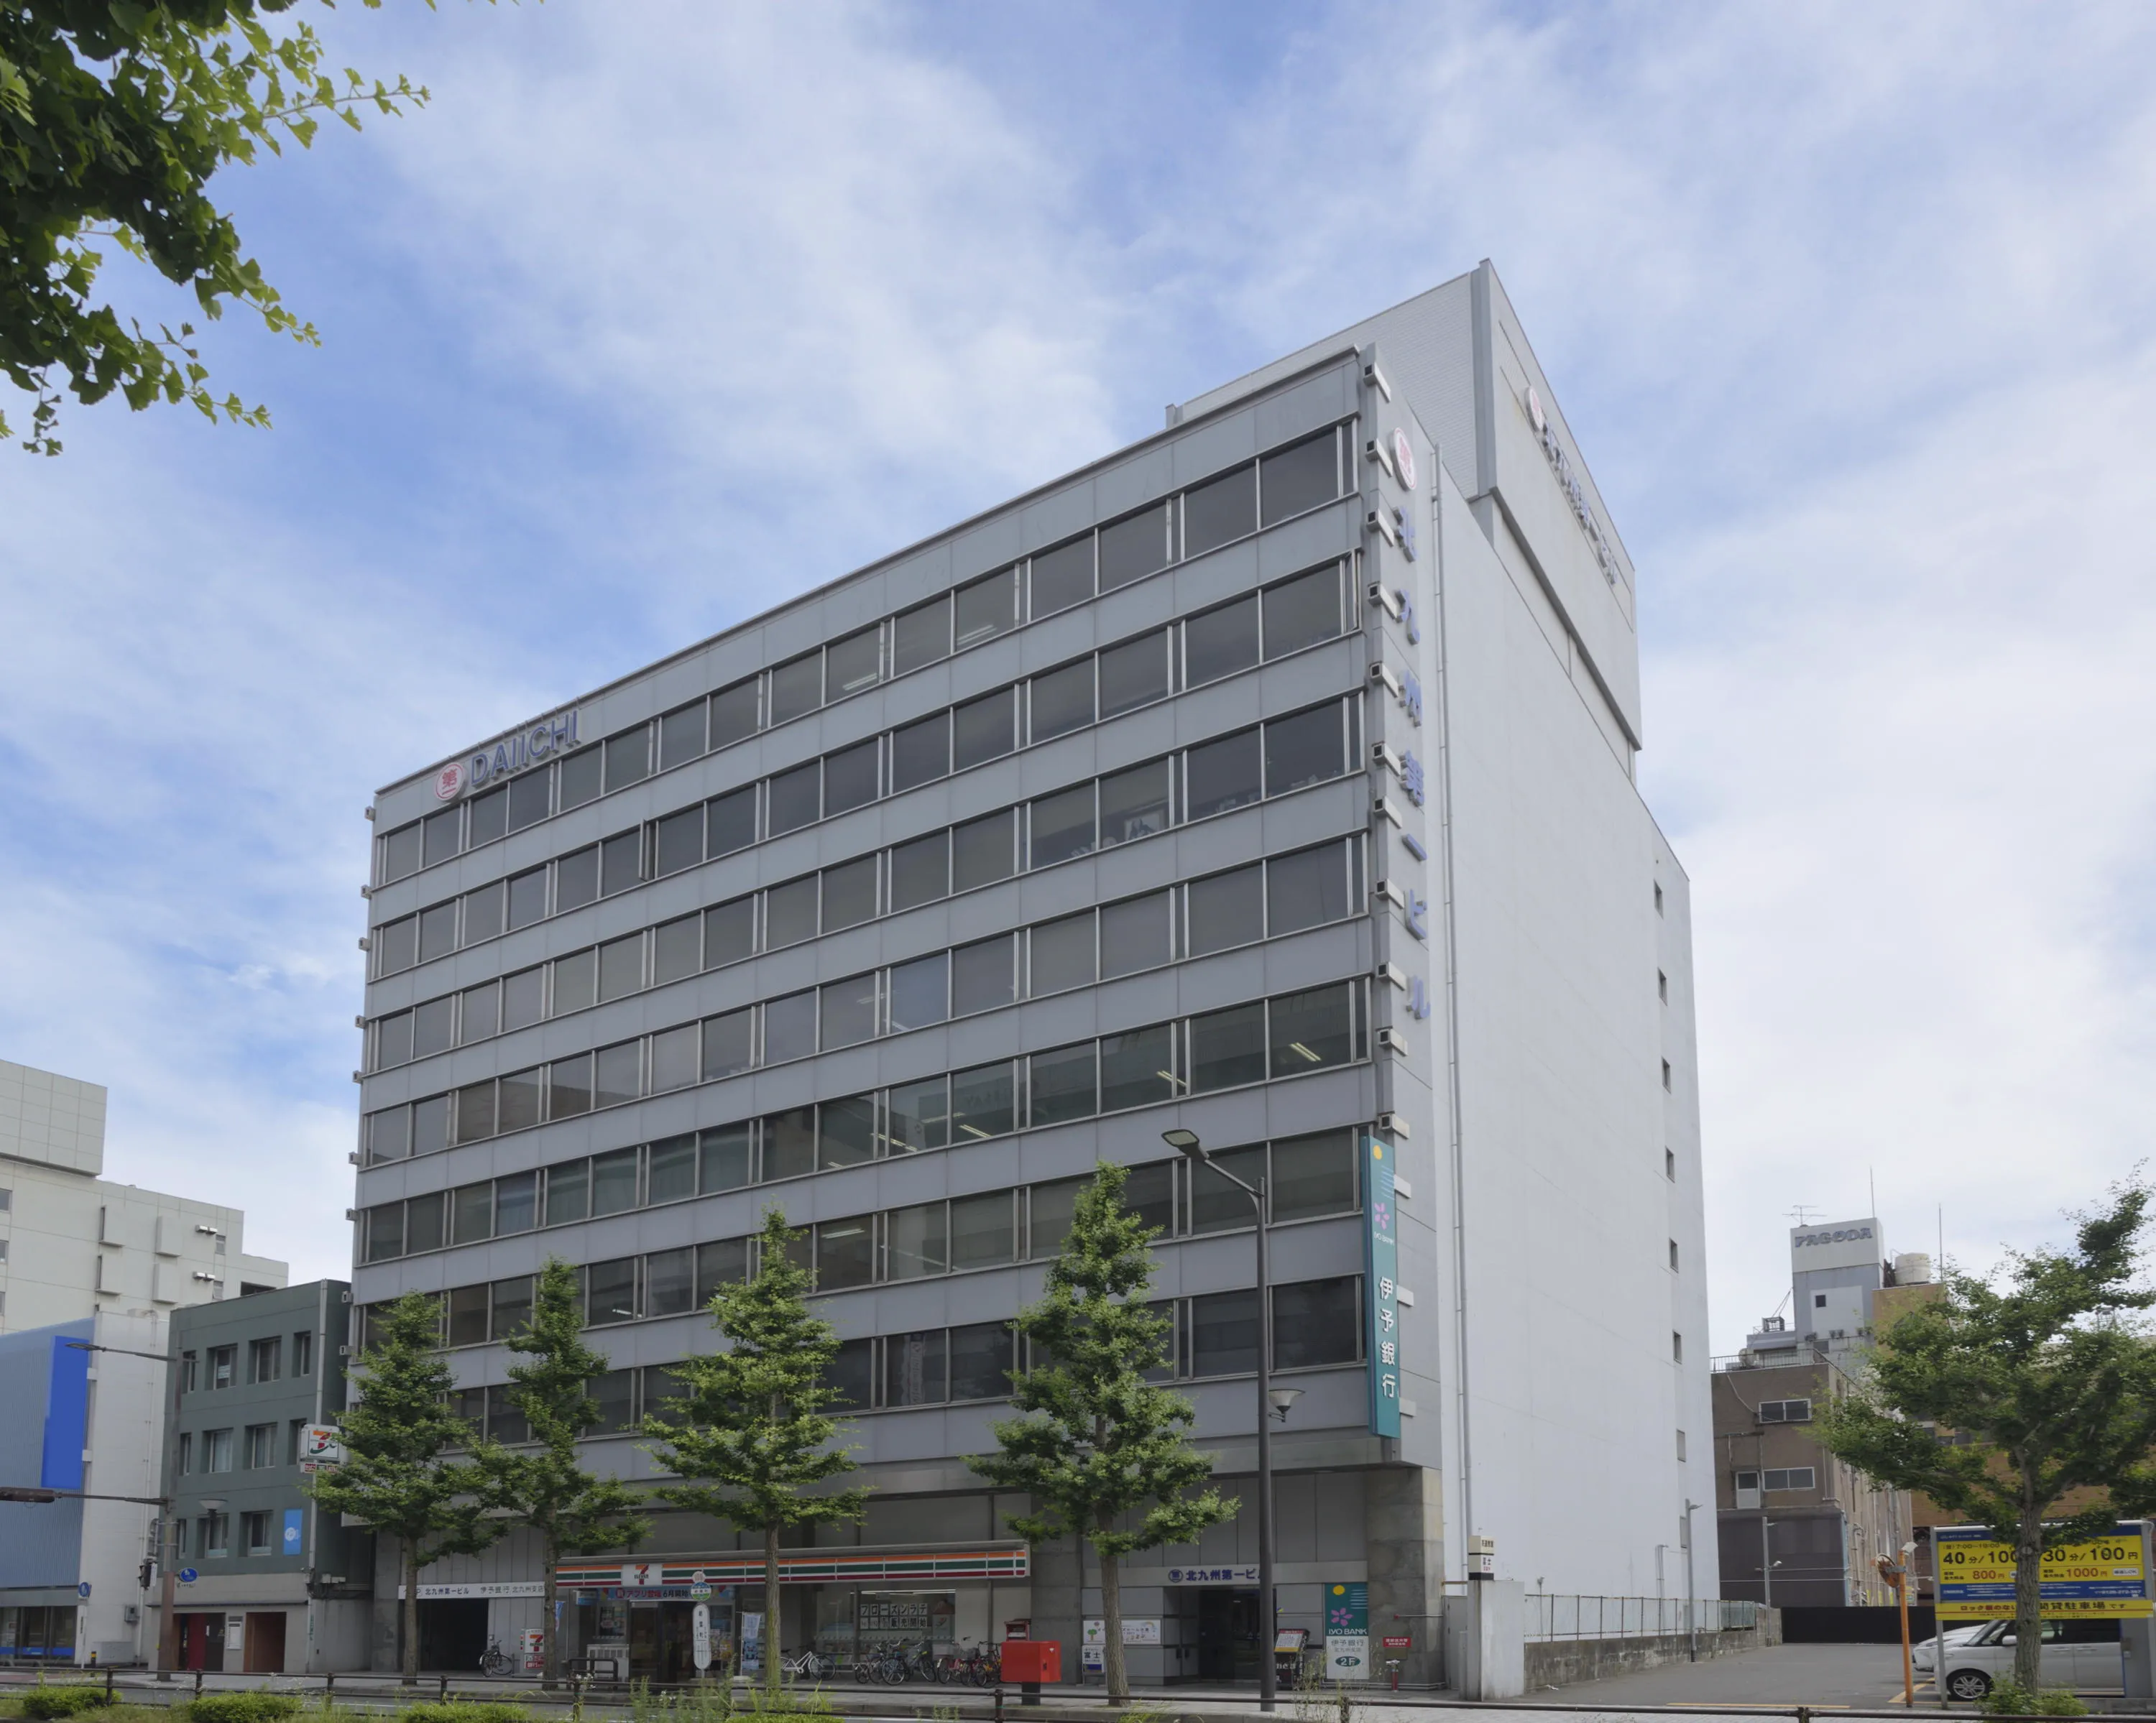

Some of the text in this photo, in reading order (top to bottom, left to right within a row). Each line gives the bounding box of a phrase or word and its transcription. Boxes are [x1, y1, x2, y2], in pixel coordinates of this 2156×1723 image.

[471, 711, 581, 786] DAIICHI
[1379, 1275, 1396, 1398] 伊予銀行
[1186, 1569, 1261, 1581] 北九州第一ビ
[861, 1604, 926, 1615] フローズンラテ
